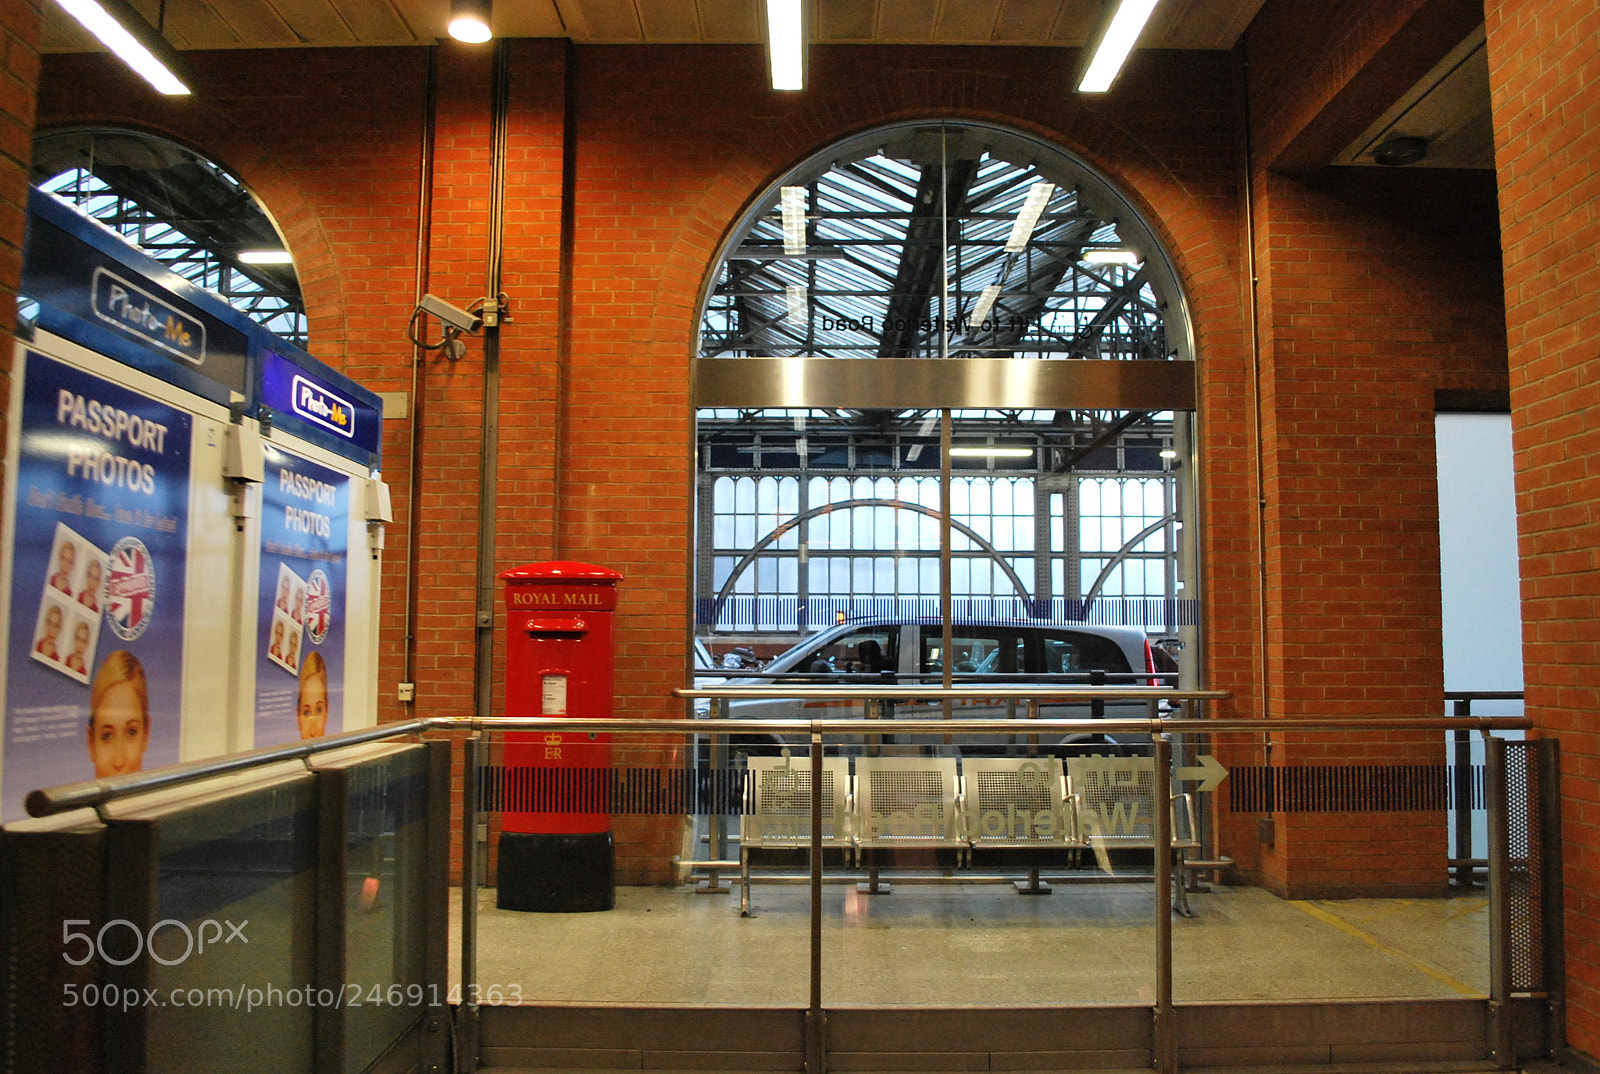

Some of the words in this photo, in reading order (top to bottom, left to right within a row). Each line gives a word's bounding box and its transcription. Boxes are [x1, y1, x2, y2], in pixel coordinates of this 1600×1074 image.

[109, 284, 192, 347] Photo-Me
[58, 389, 169, 454] PASSPORT
[301, 385, 347, 426] Photo-Me
[67, 444, 156, 495] PHOTOS
[280, 468, 337, 507] PASSPORT
[285, 505, 331, 538] PHOTOS
[513, 592, 560, 605] ROYAL
[563, 593, 603, 605] MAIL
